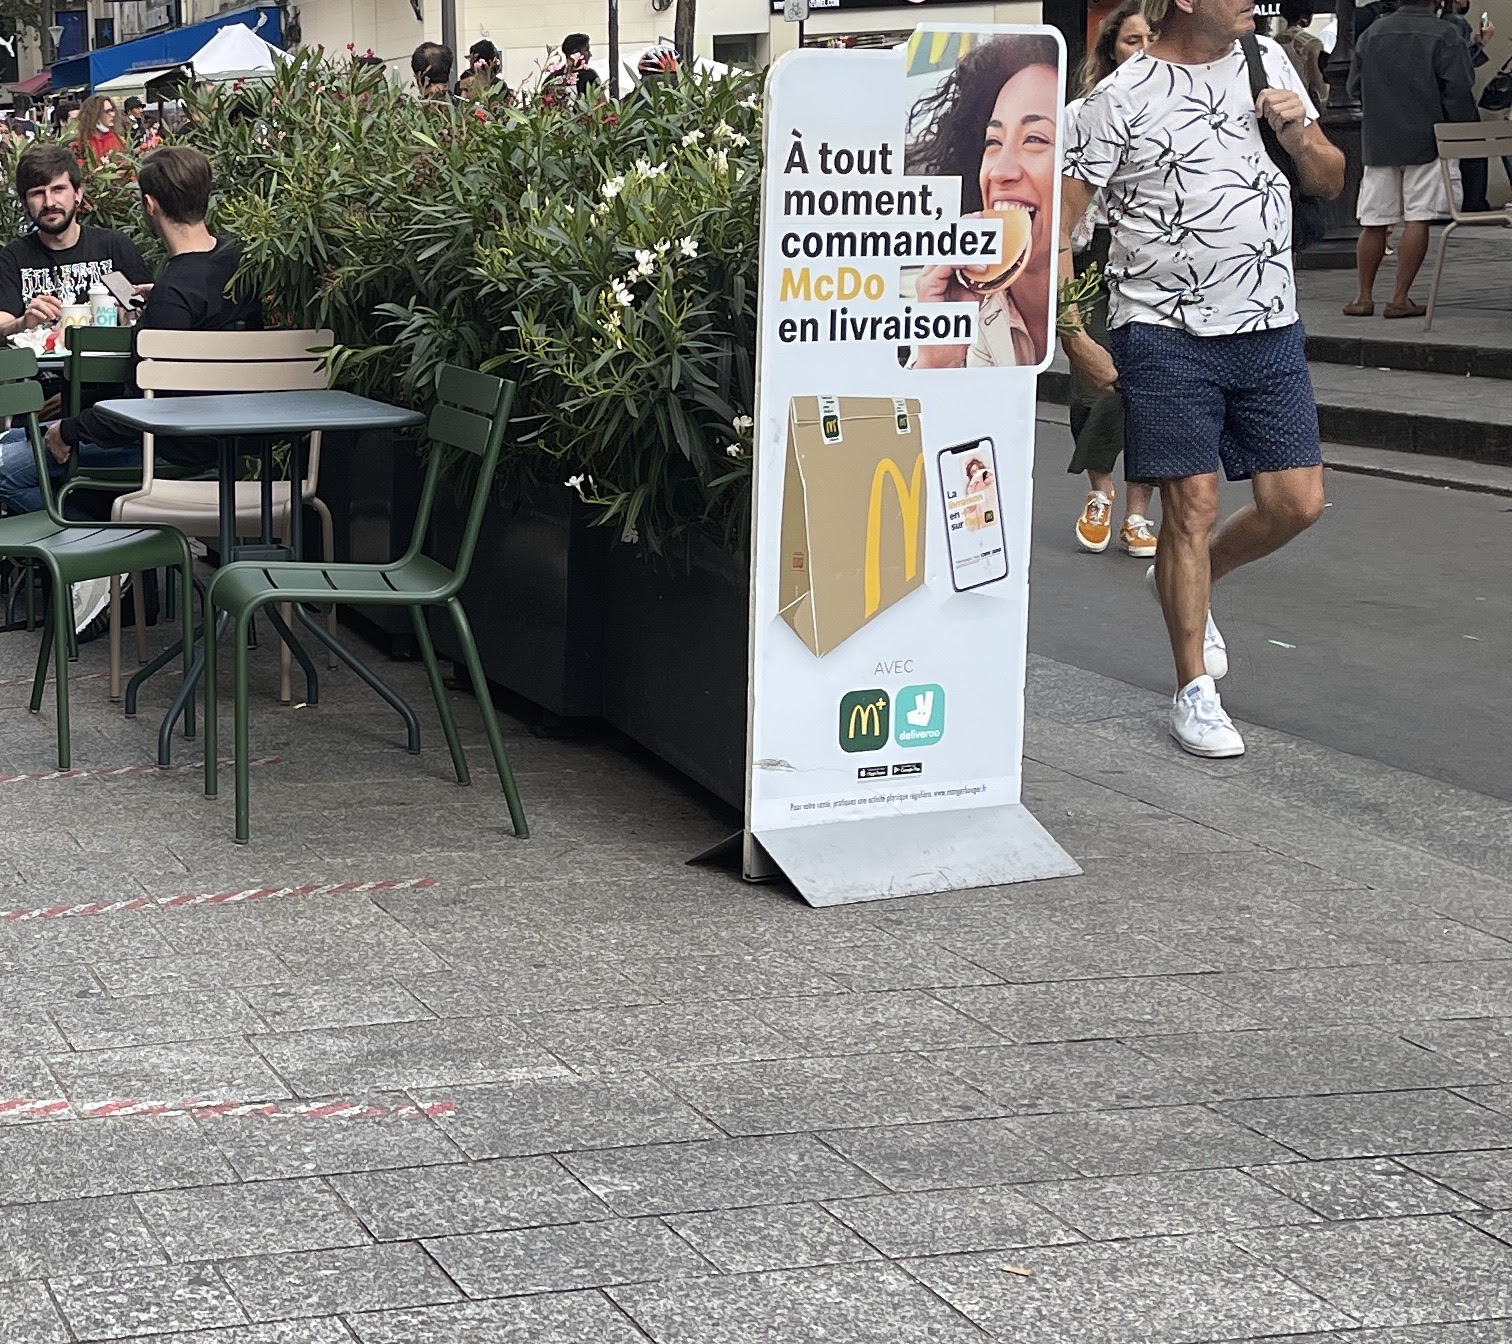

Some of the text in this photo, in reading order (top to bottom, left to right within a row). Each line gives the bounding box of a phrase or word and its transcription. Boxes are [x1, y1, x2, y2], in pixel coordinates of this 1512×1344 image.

[783, 128, 893, 175] À tout
[783, 183, 943, 221] moment,
[781, 223, 997, 258] commandez
[779, 266, 885, 302] McDo
[778, 305, 972, 343] en livraison
[873, 659, 915, 676] AVEC
[899, 729, 940, 741] deliveroo
